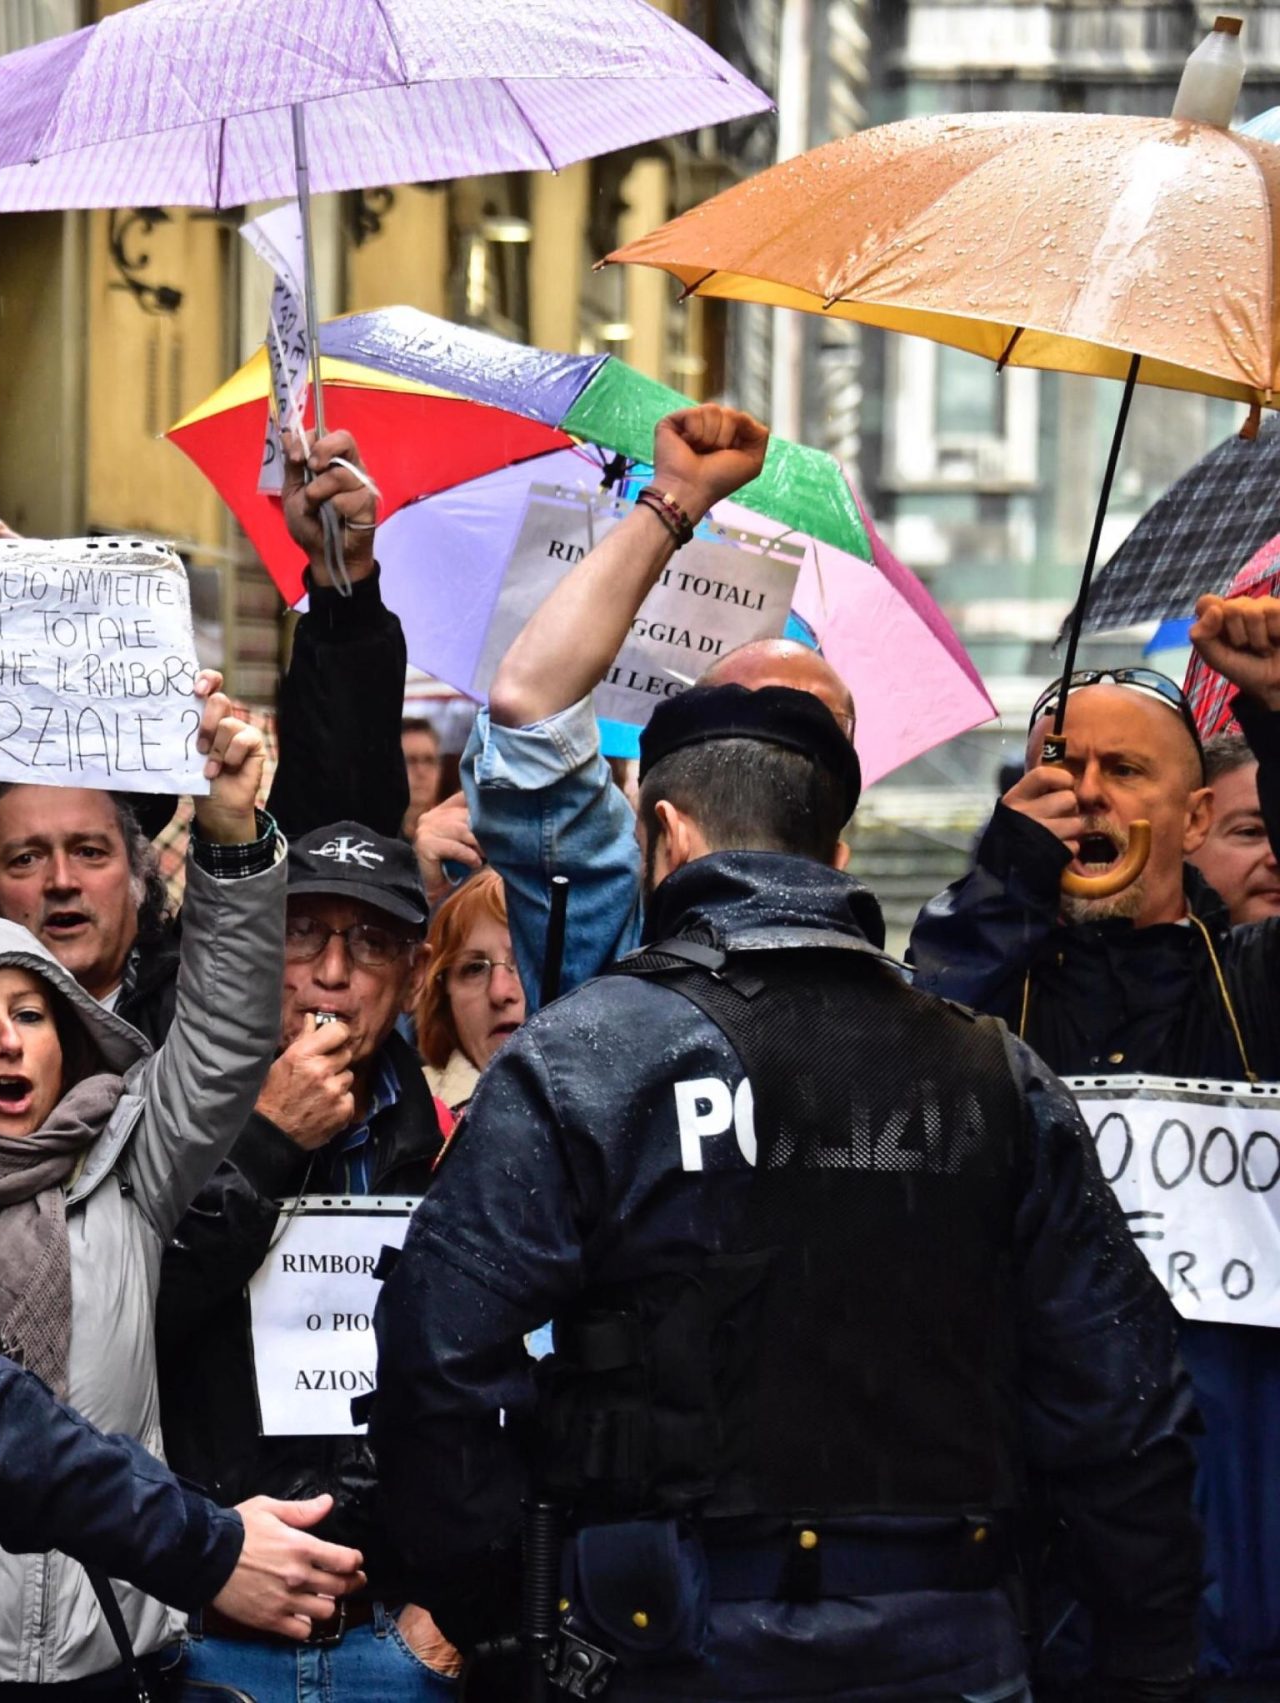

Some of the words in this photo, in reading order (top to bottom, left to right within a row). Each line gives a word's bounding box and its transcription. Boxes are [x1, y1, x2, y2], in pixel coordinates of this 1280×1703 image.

[677, 572, 766, 611] TOTALI
[631, 618, 692, 648] GGIA
[697, 635, 723, 656] DI
[281, 1254, 375, 1274] RIMBOR
[332, 1313, 370, 1332] PIO
[295, 1370, 375, 1391] AZION
